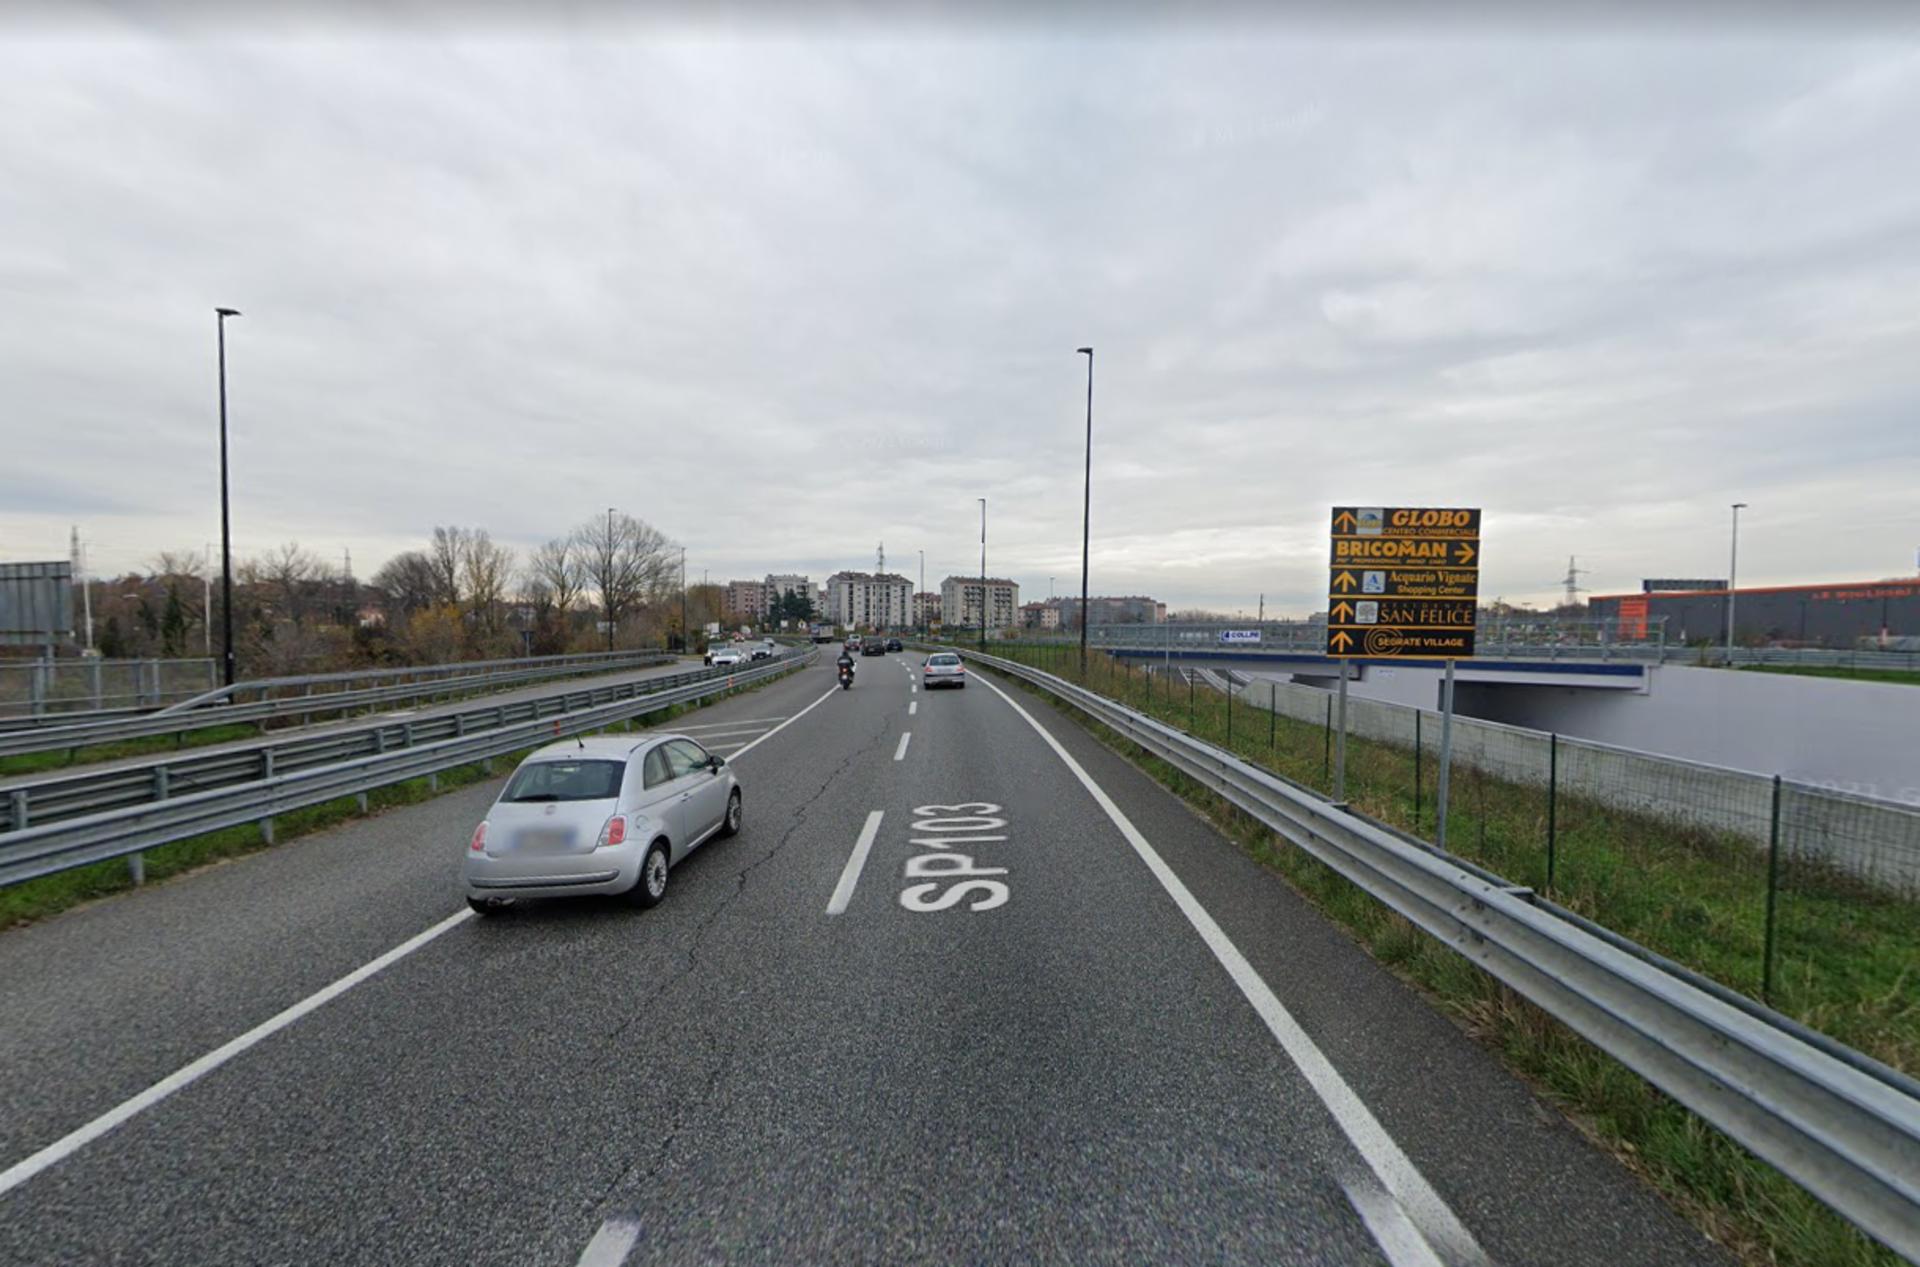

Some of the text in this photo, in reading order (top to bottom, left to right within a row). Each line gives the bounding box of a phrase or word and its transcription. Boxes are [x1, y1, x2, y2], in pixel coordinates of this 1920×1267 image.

[1392, 511, 1471, 526] GLOBO
[1336, 540, 1447, 557] BRICOMAN
[1389, 571, 1435, 584] Acquario
[1397, 585, 1436, 595] Shopping
[1380, 609, 1472, 624] SAN FELICE
[1378, 637, 1464, 647] SEGRATE VILLAGE
[900, 802, 1009, 912] SP103
